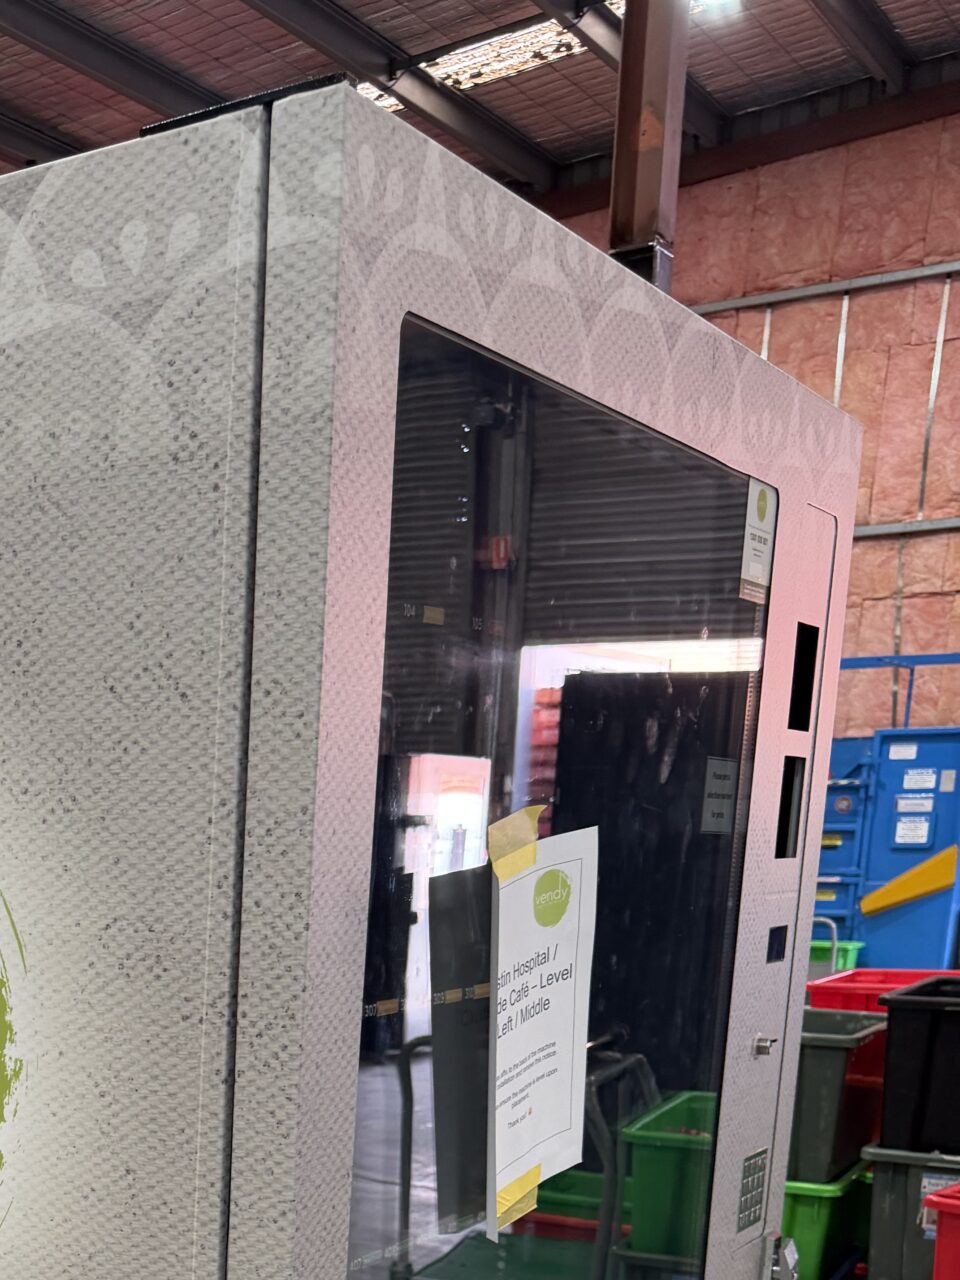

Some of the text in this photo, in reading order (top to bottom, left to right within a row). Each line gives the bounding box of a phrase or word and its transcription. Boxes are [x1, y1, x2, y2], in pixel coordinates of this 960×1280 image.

[513, 946, 550, 981] Hospital
[509, 981, 529, 1006] Café
[540, 963, 573, 989] Level
[520, 997, 551, 1024] Middle
